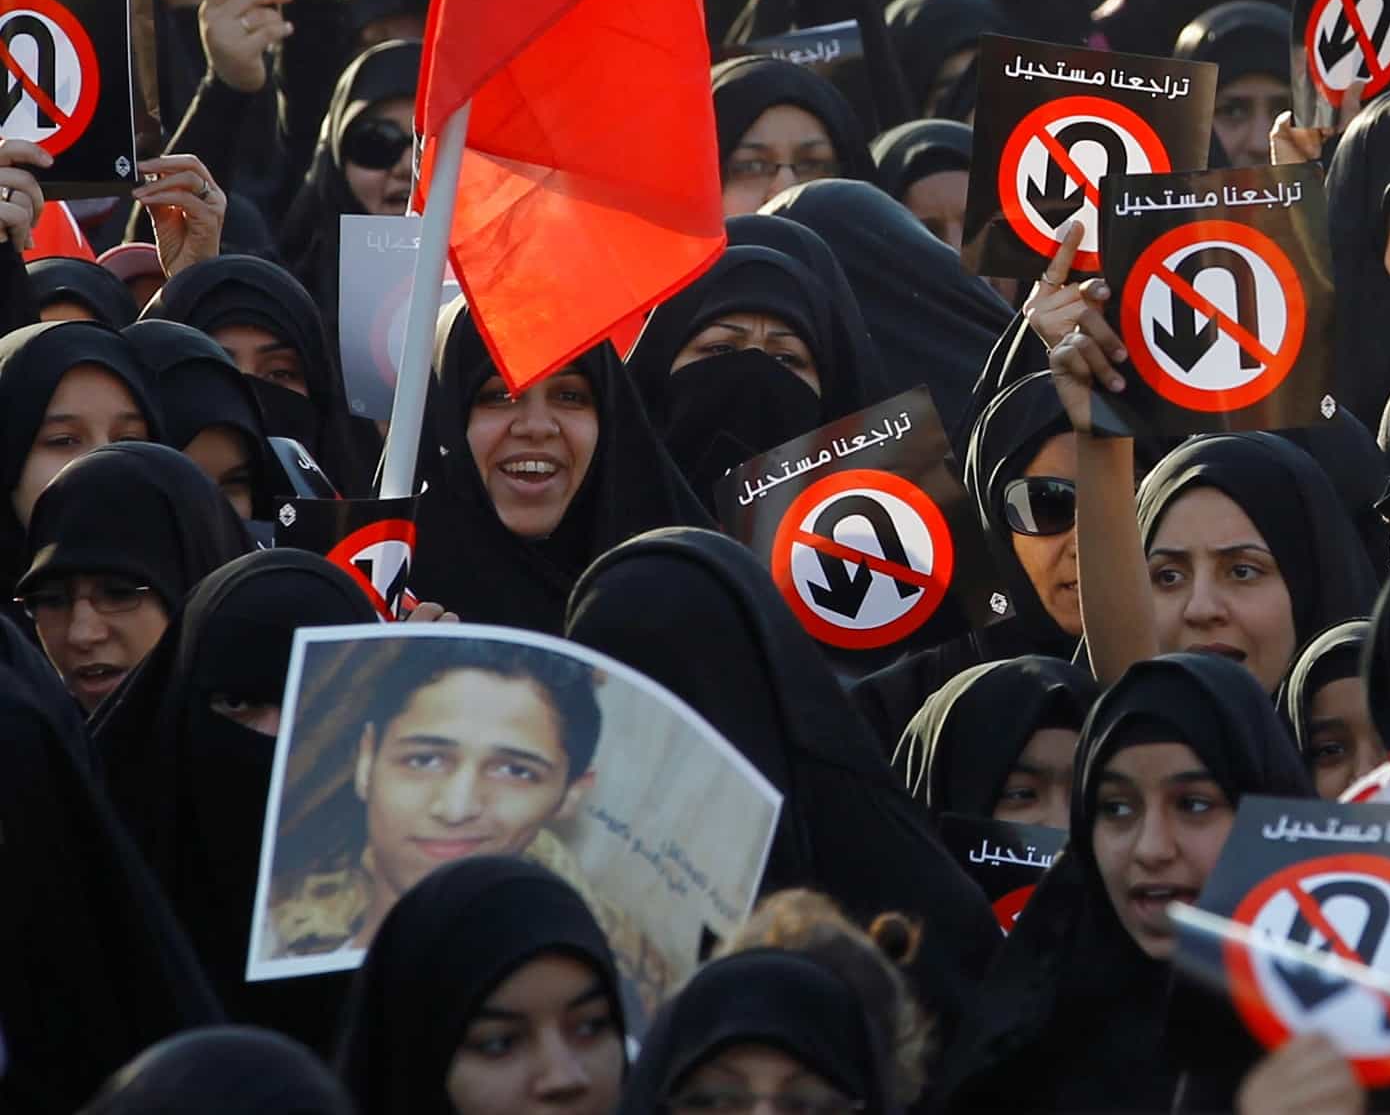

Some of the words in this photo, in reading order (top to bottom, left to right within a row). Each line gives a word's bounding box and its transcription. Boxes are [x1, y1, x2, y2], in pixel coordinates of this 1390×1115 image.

[1004, 55, 1106, 87] مستحيل
[1110, 68, 1190, 99] تراجعنا
[1115, 189, 1219, 216] مستحيل
[1222, 181, 1302, 208] تراجعنا
[832, 411, 912, 456] تراجعنا
[738, 449, 833, 506] مستحيل
[1262, 814, 1382, 844] مستحيل
[968, 839, 1055, 869] ستحيل
